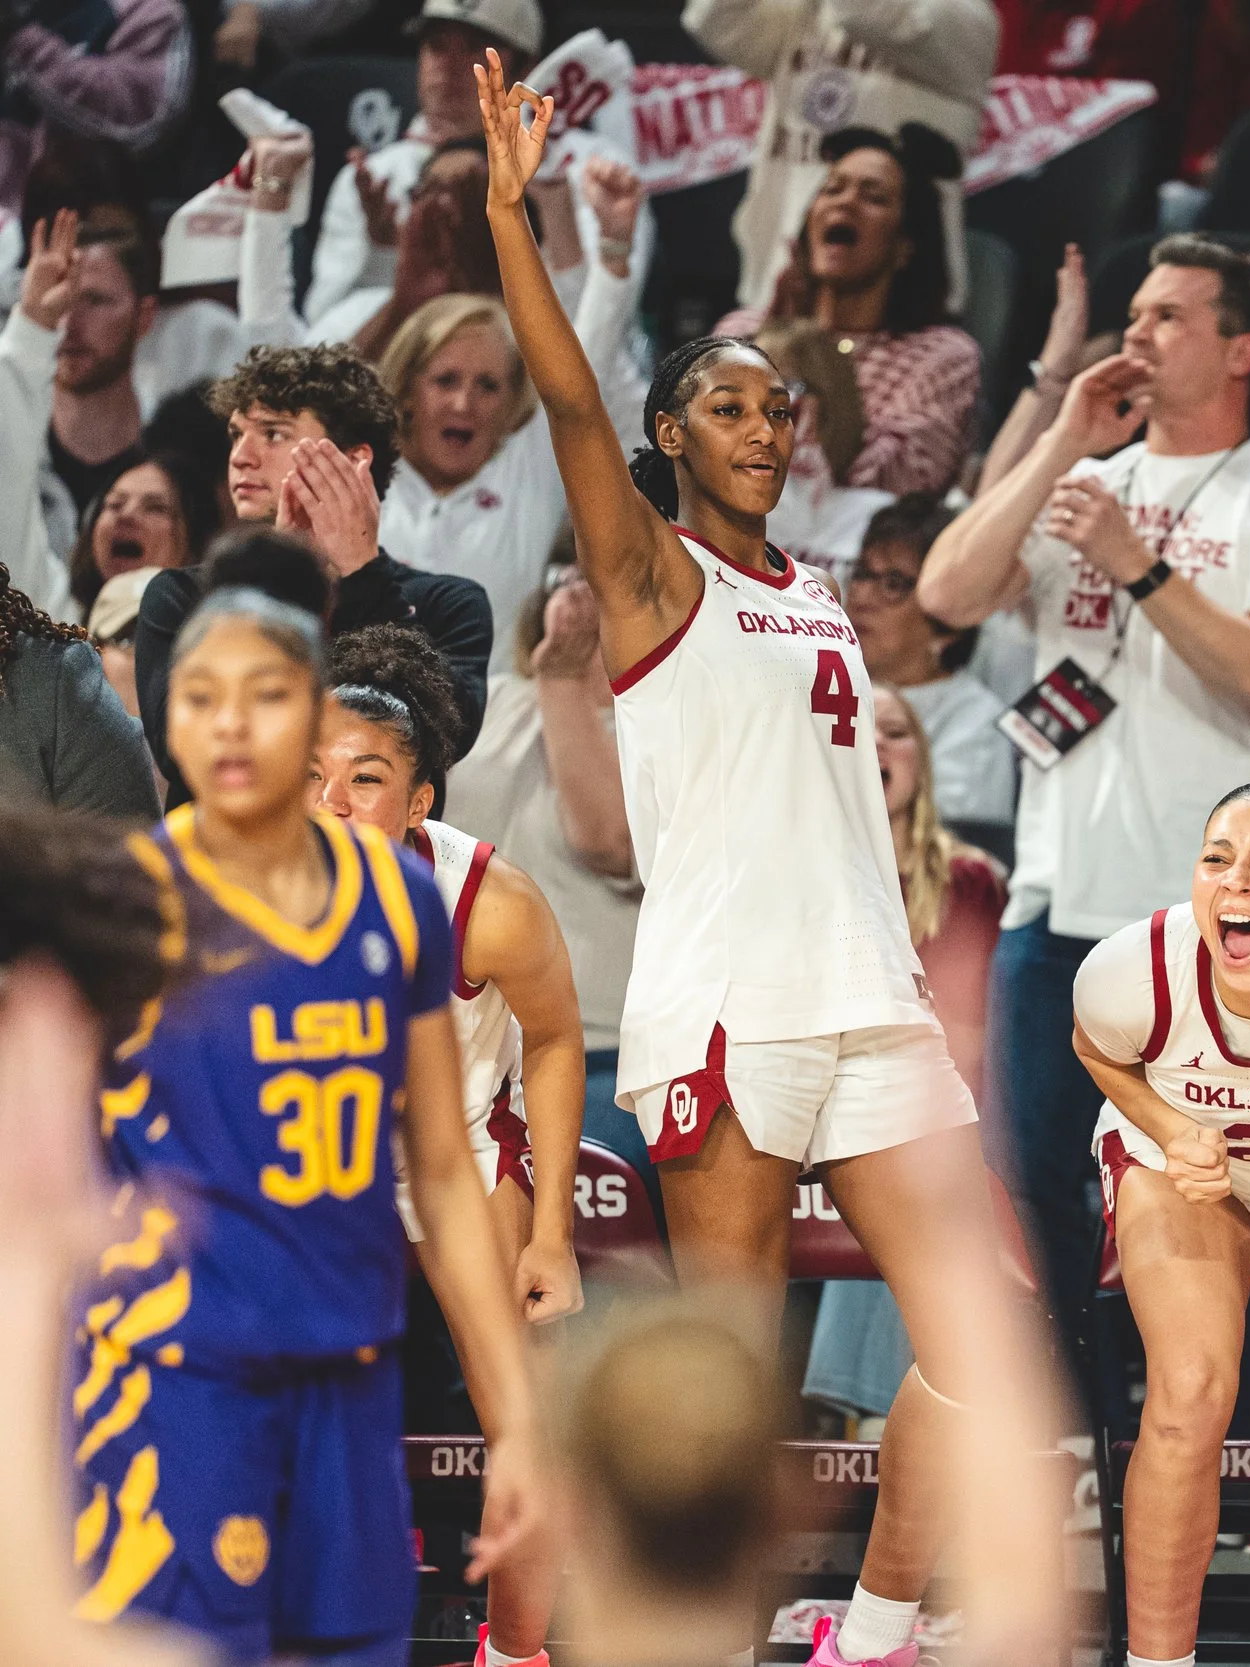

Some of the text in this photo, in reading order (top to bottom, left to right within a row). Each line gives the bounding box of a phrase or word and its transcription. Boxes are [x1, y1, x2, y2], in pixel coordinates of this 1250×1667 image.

[811, 649, 859, 748] 4
[251, 997, 387, 1063] LSU
[260, 1068, 383, 1206] 30
[670, 1083, 698, 1134] OU
